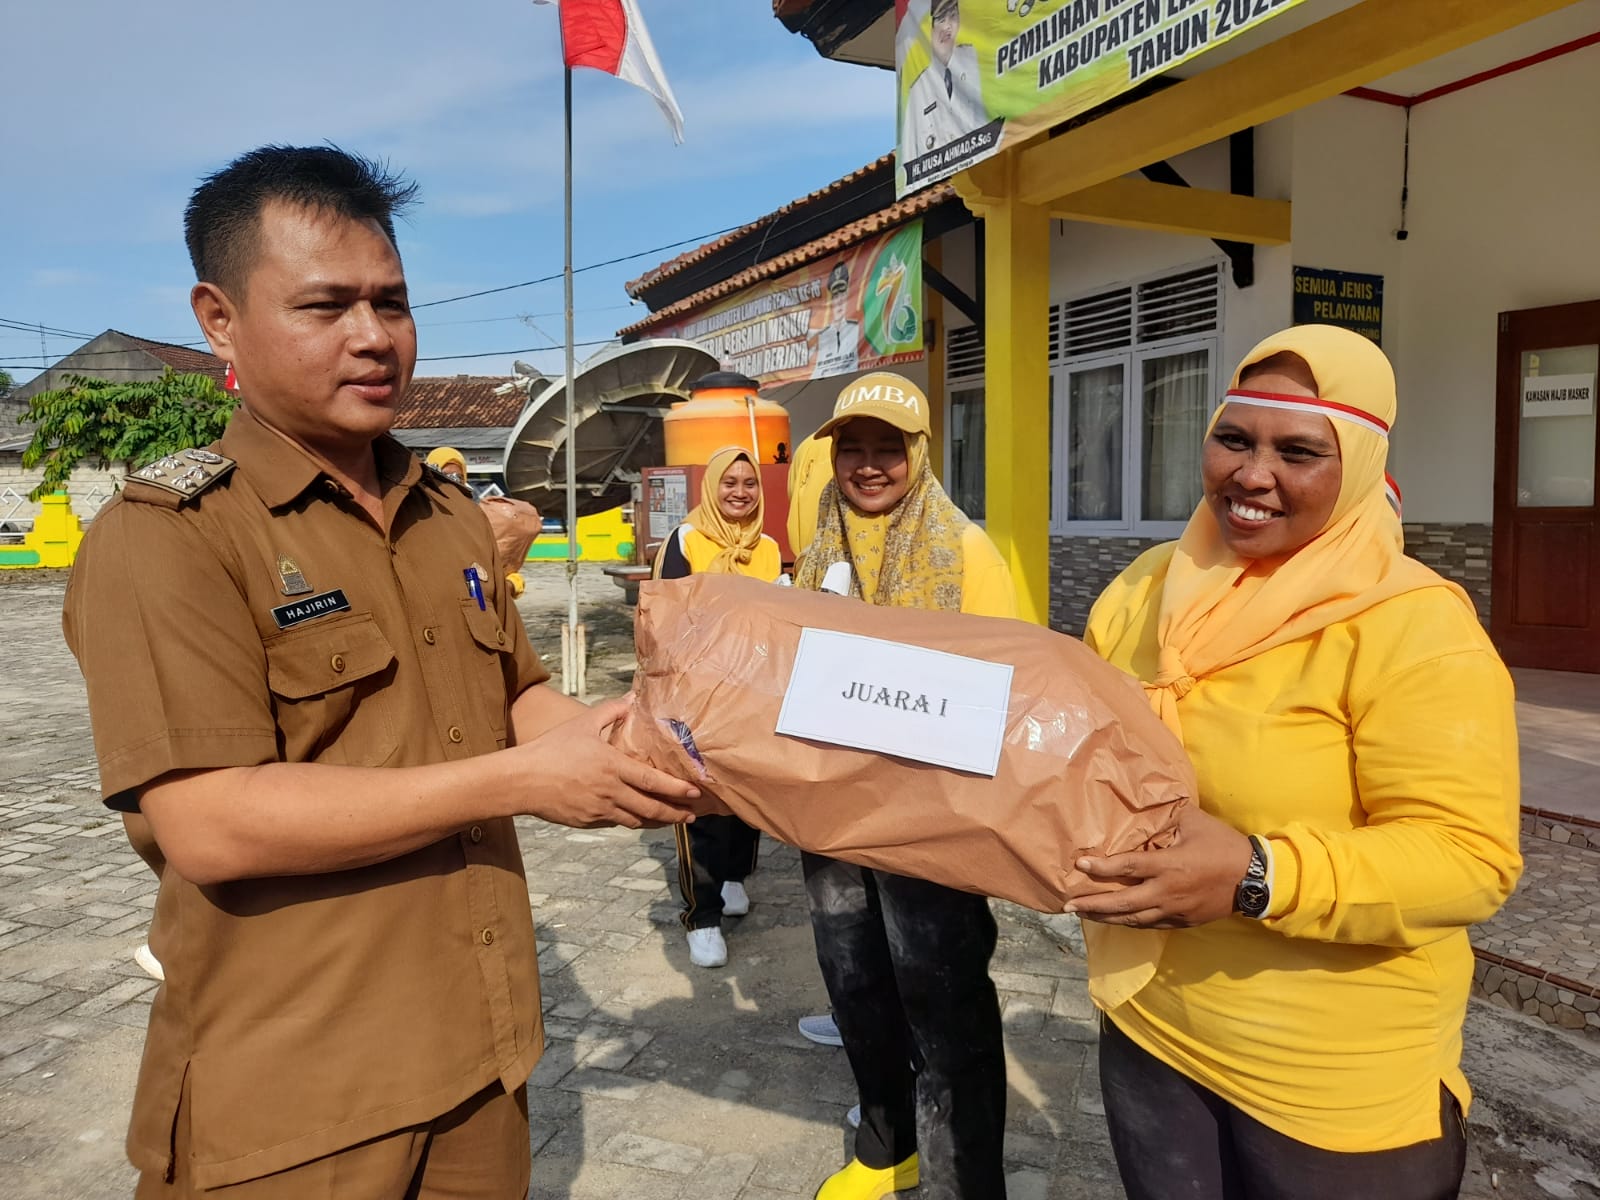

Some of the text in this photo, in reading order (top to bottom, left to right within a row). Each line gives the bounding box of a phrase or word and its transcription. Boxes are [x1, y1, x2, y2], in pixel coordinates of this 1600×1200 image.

[997, 0, 1099, 75] PEMILIHAN
[1040, 0, 1160, 87] KABUPATEN
[1128, 8, 1208, 80] TAHUN
[922, 153, 943, 173] MUSA
[1295, 276, 1374, 300] SEMUA JENIS
[1313, 301, 1380, 322] PELAYANAN
[763, 340, 808, 375] BERJAYA
[1567, 386, 1590, 401] MASKER
[285, 596, 337, 619] HAJIRIN
[841, 681, 949, 717] JUARA I
